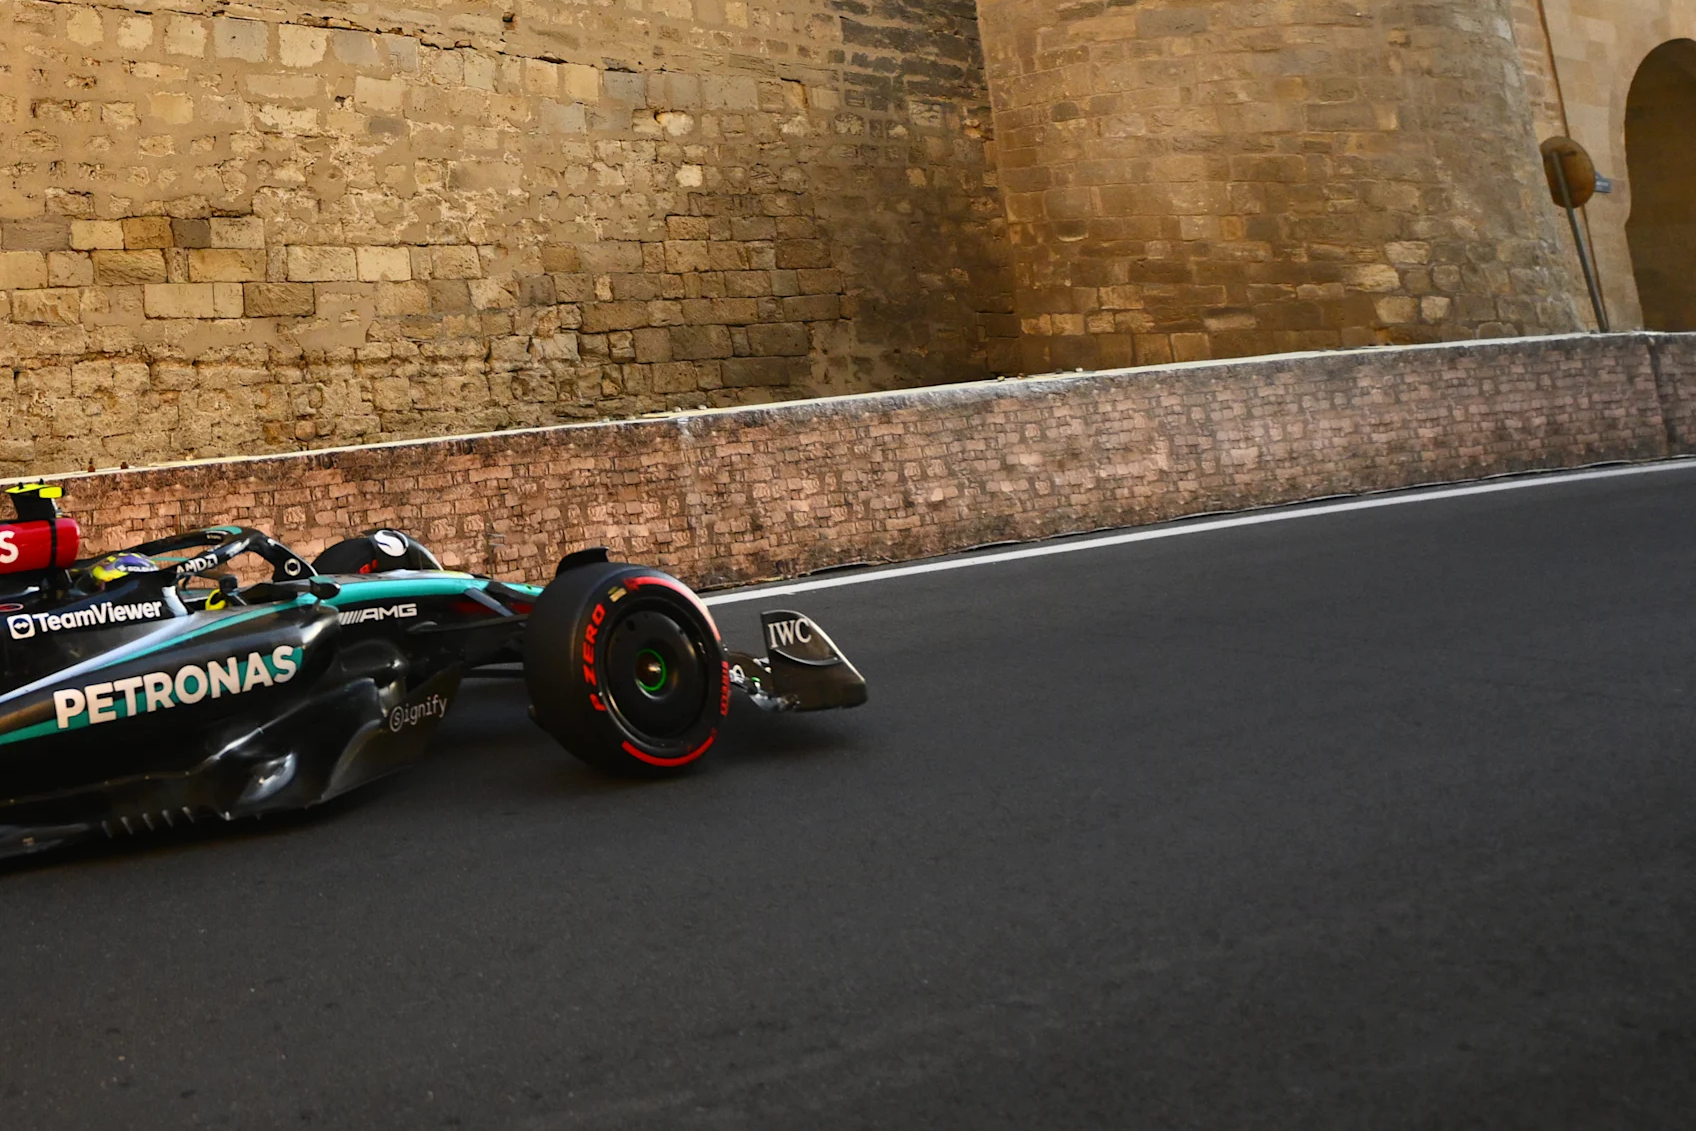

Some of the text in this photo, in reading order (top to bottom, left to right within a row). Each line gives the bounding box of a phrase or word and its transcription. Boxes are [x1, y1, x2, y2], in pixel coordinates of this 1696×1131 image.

[32, 599, 162, 633] TeamViewer
[360, 603, 417, 623] AMG
[582, 603, 606, 686] ZERO
[767, 618, 812, 649] IWC
[53, 645, 297, 729] PETRONAS
